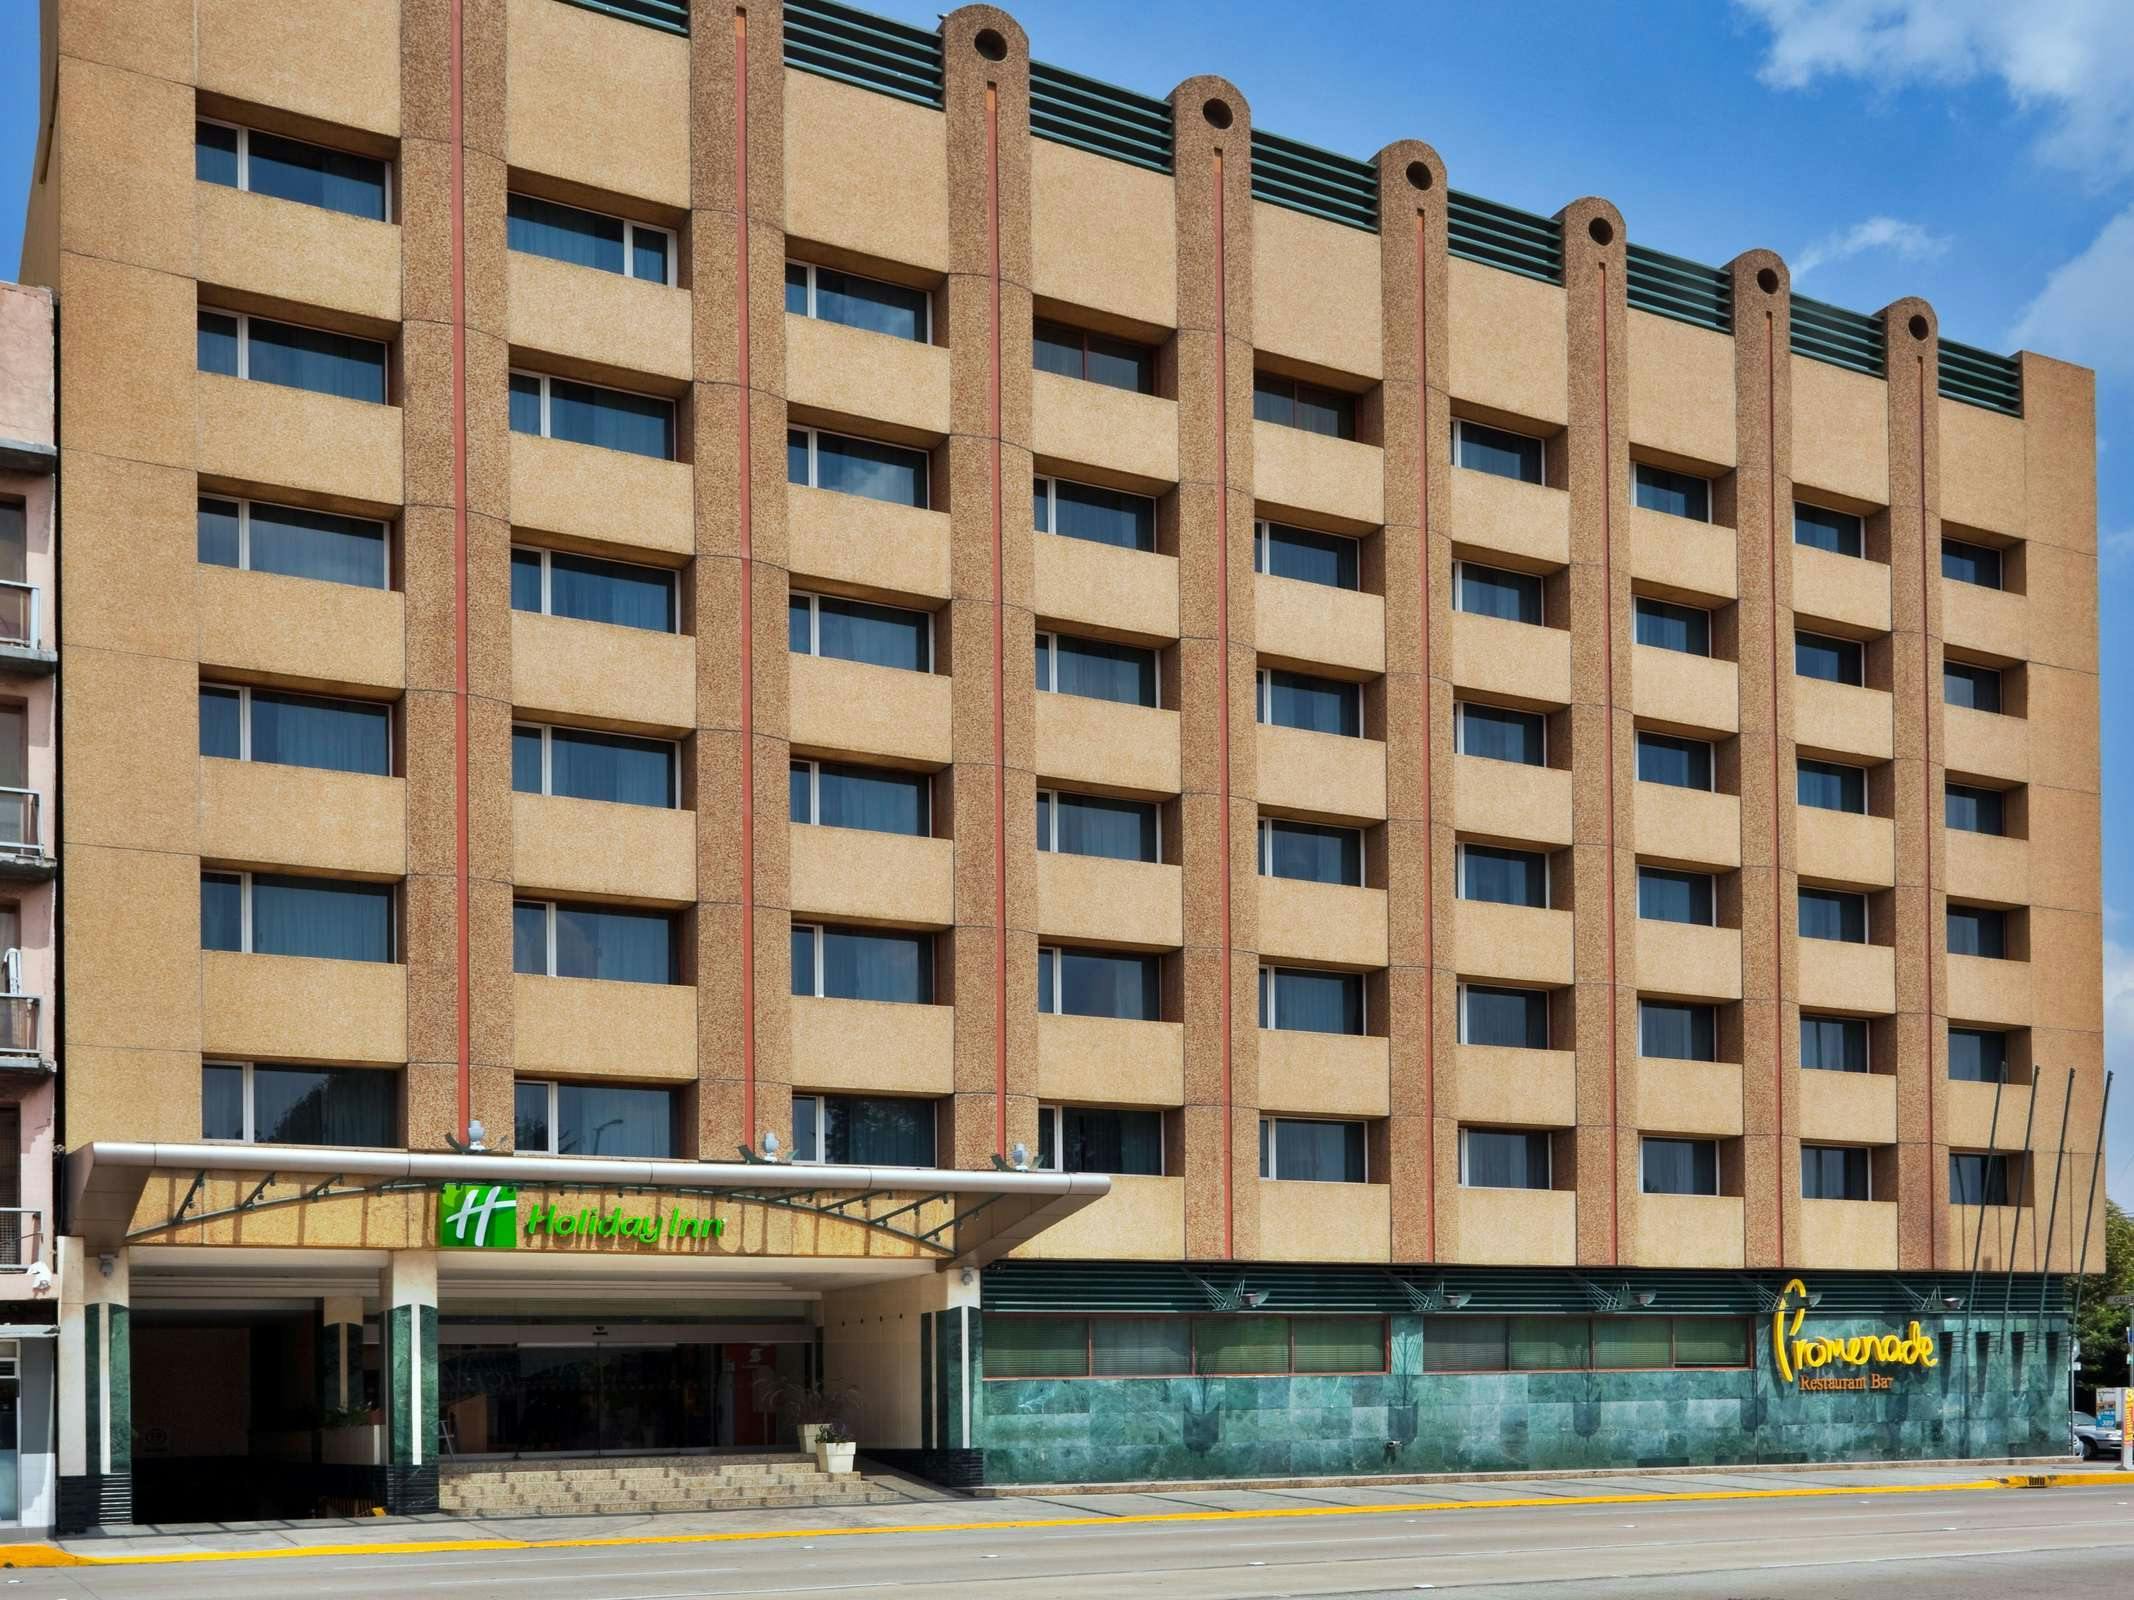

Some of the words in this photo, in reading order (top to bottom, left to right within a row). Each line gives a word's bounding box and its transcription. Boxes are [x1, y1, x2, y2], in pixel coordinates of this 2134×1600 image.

[528, 1203, 662, 1244] Holiday
[670, 1207, 725, 1239] Inn
[1773, 1278, 1939, 1383] Promenade
[1800, 1375, 1866, 1392] Restaurant
[1871, 1374, 1894, 1391] Bar
